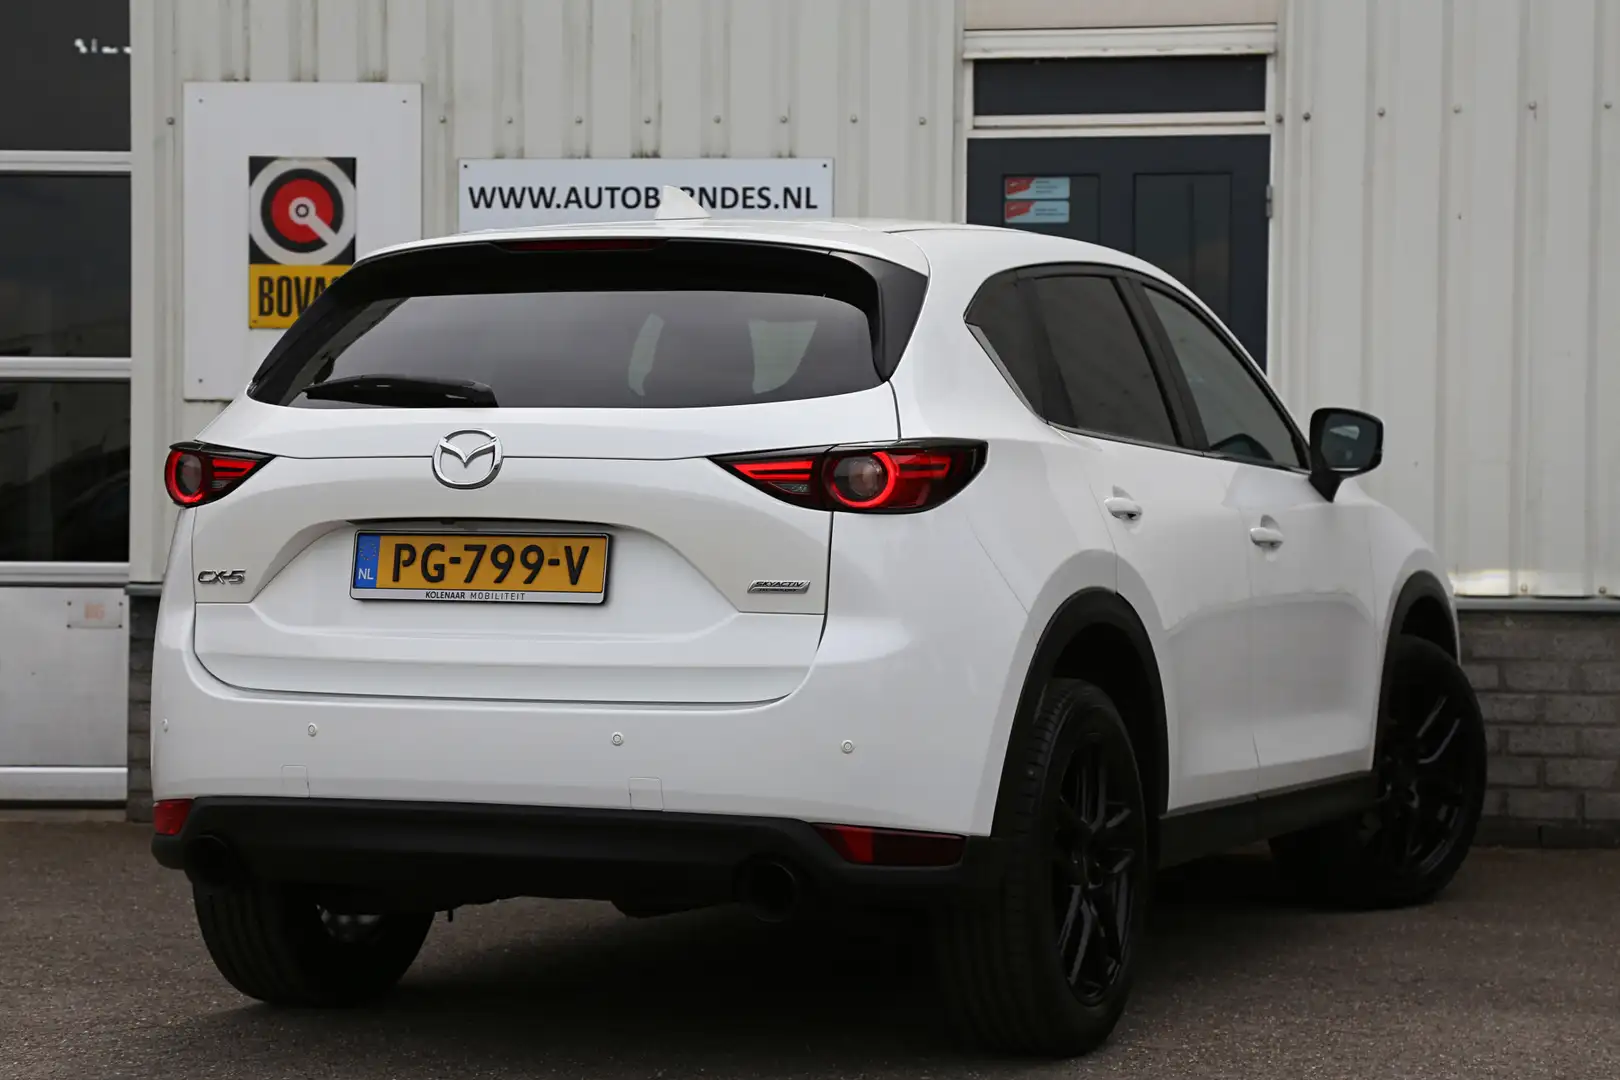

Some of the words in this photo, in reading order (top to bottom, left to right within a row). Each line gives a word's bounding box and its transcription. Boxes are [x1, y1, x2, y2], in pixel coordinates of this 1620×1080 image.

[468, 186, 818, 209] WWW.AUTOBNDES.NL
[258, 276, 341, 317] BOVA
[357, 567, 375, 581] NL
[392, 543, 590, 586] PG-799-V
[198, 569, 246, 585] CX-5
[425, 591, 466, 599] KOLENAAR
[470, 592, 526, 600] MOBILITEIT
